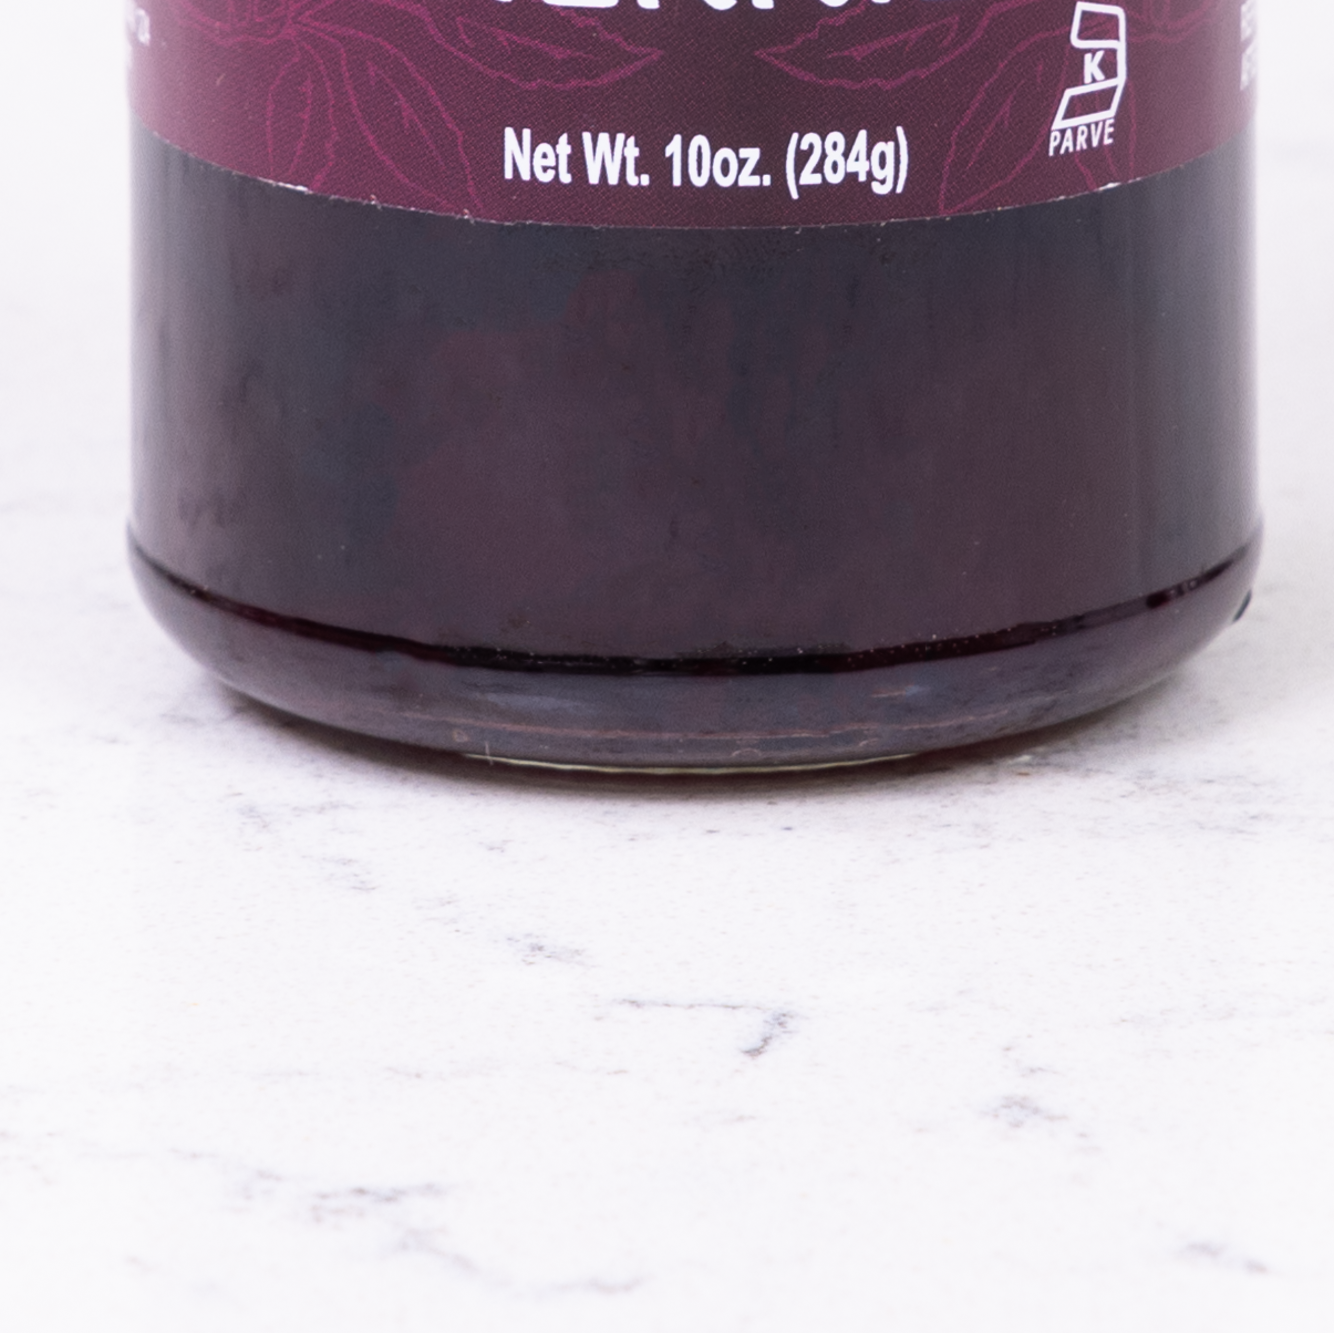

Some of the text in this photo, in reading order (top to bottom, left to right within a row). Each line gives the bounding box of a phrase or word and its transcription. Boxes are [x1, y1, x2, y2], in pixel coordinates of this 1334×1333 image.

[1083, 50, 1106, 84] K
[1048, 119, 1115, 157] PARVE
[504, 125, 909, 200] Net Wt. 10oz. (284g)
